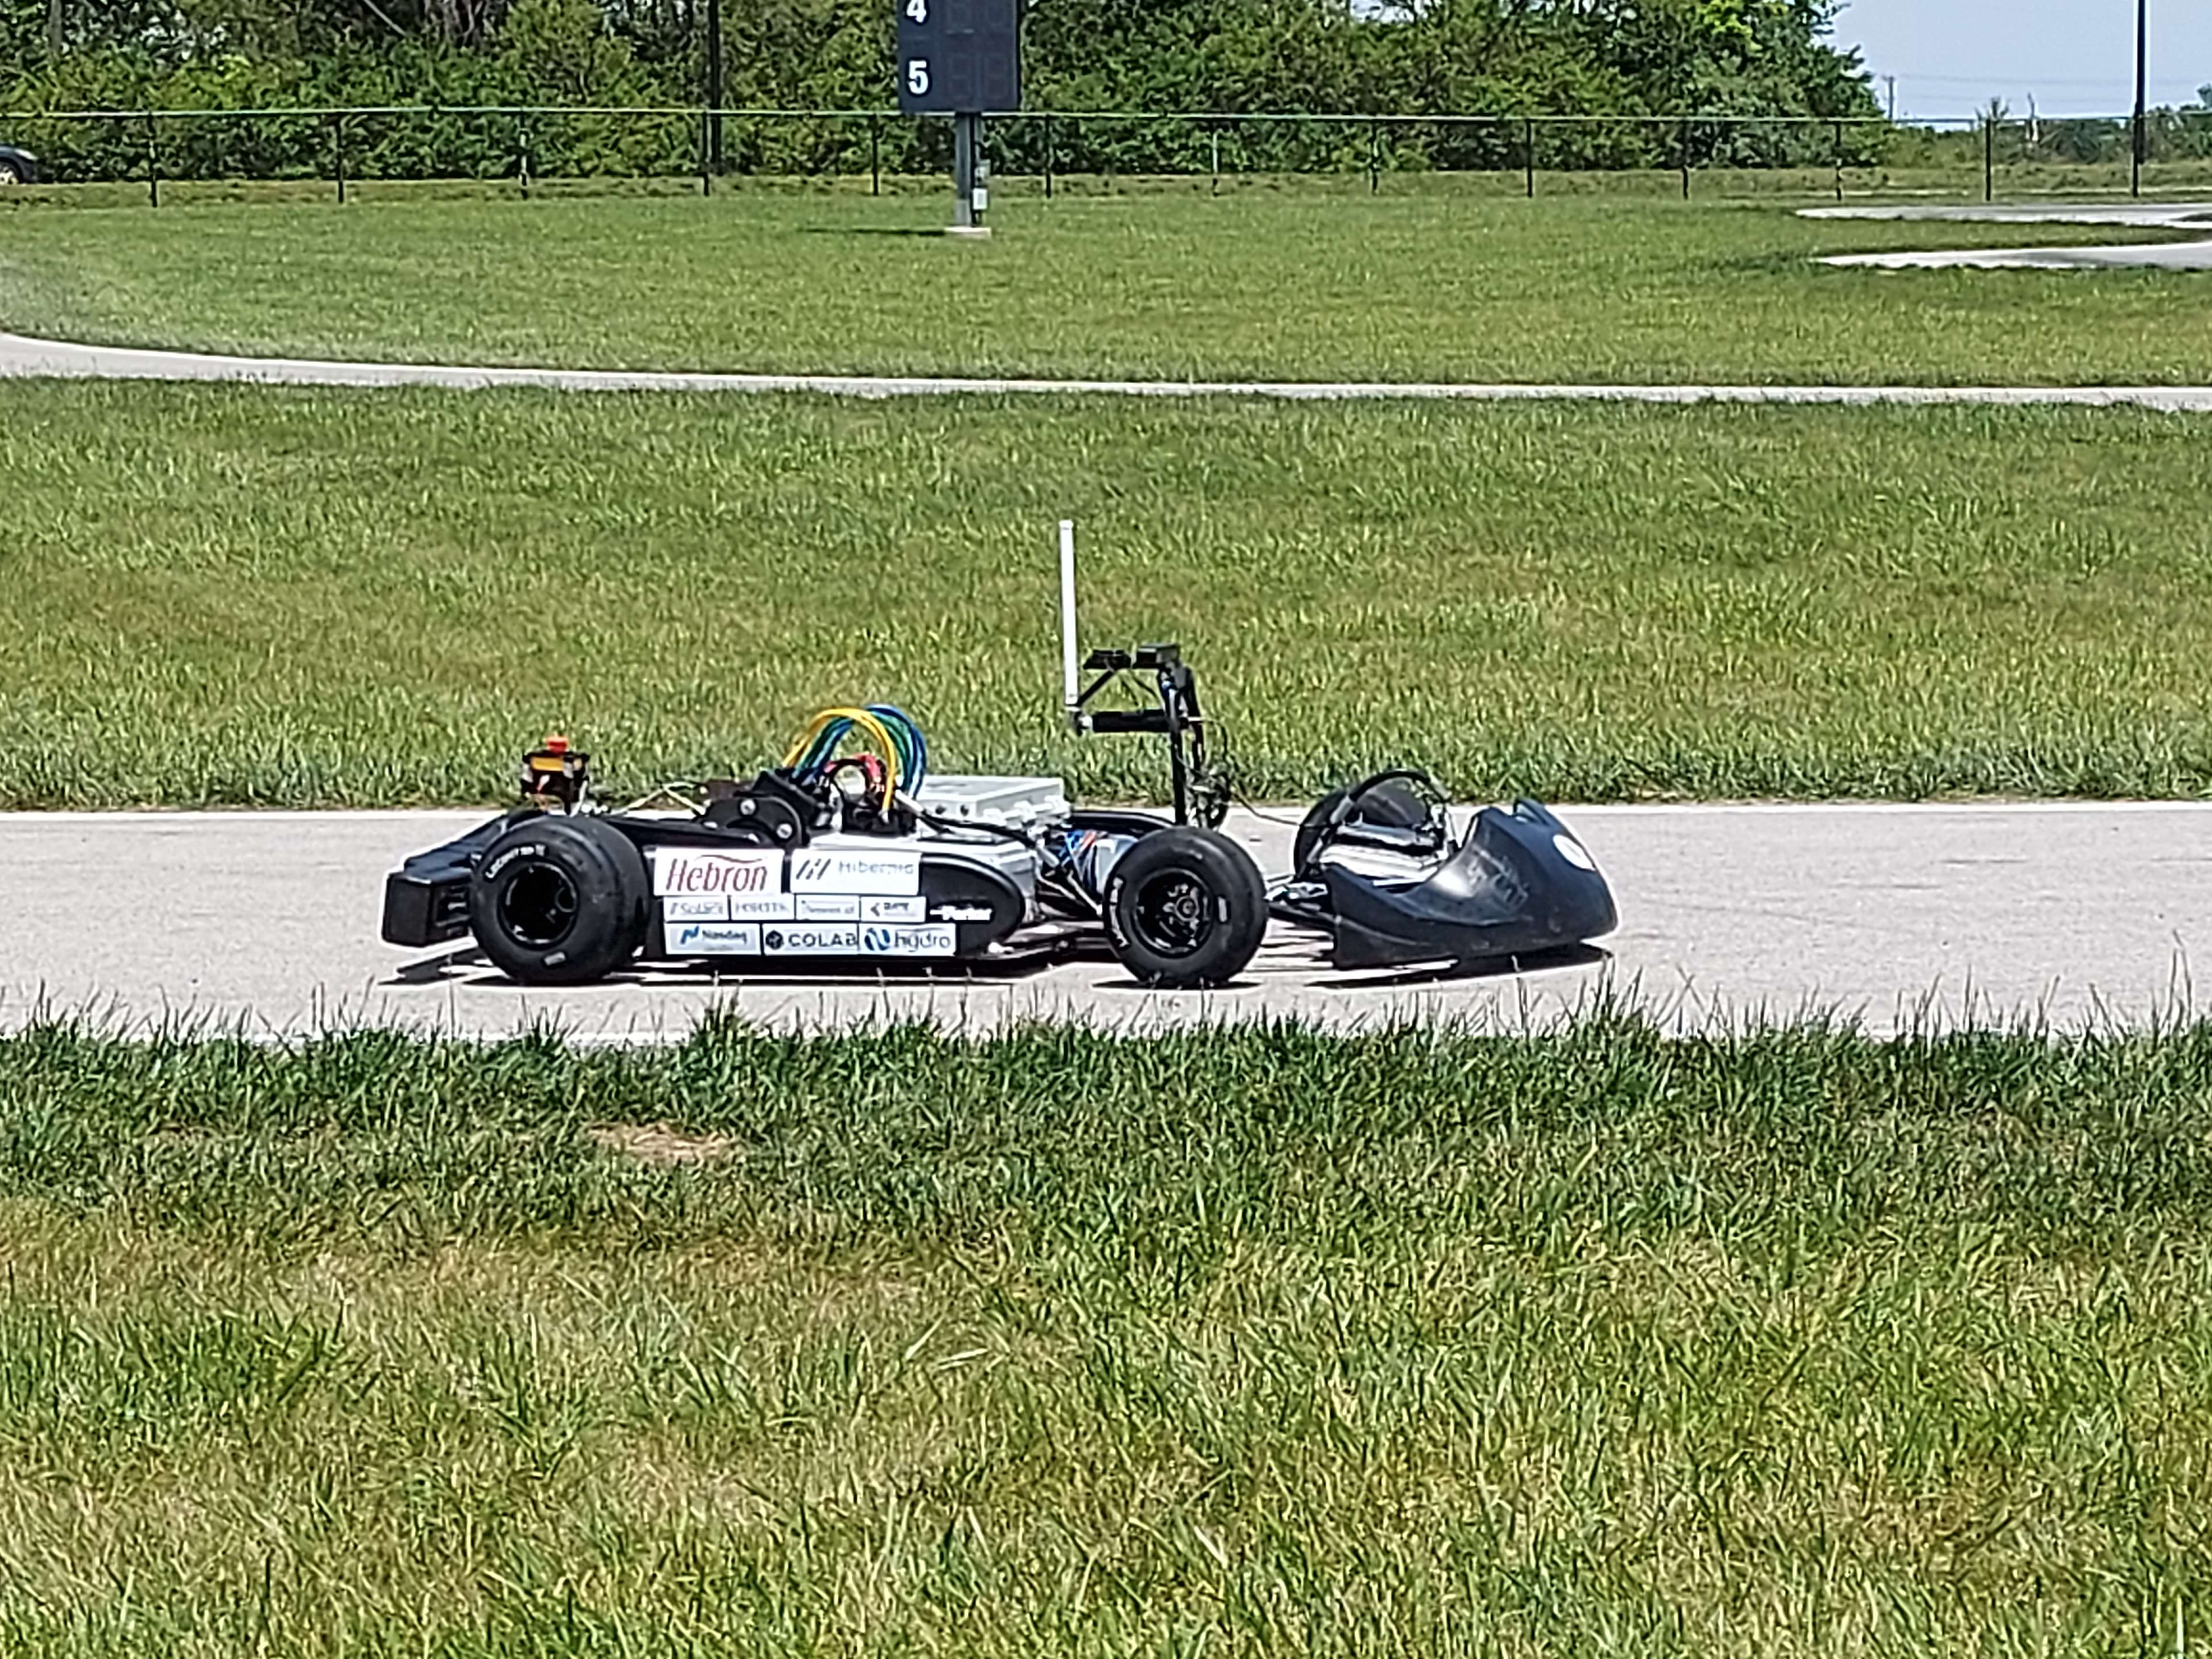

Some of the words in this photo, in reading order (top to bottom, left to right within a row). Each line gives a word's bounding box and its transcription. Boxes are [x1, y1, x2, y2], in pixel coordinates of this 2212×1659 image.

[906, 0, 927, 23] 4
[908, 60, 929, 94] 5
[665, 858, 767, 892] Hebron
[788, 932, 857, 948] COLAB
[895, 929, 951, 952] hydro
